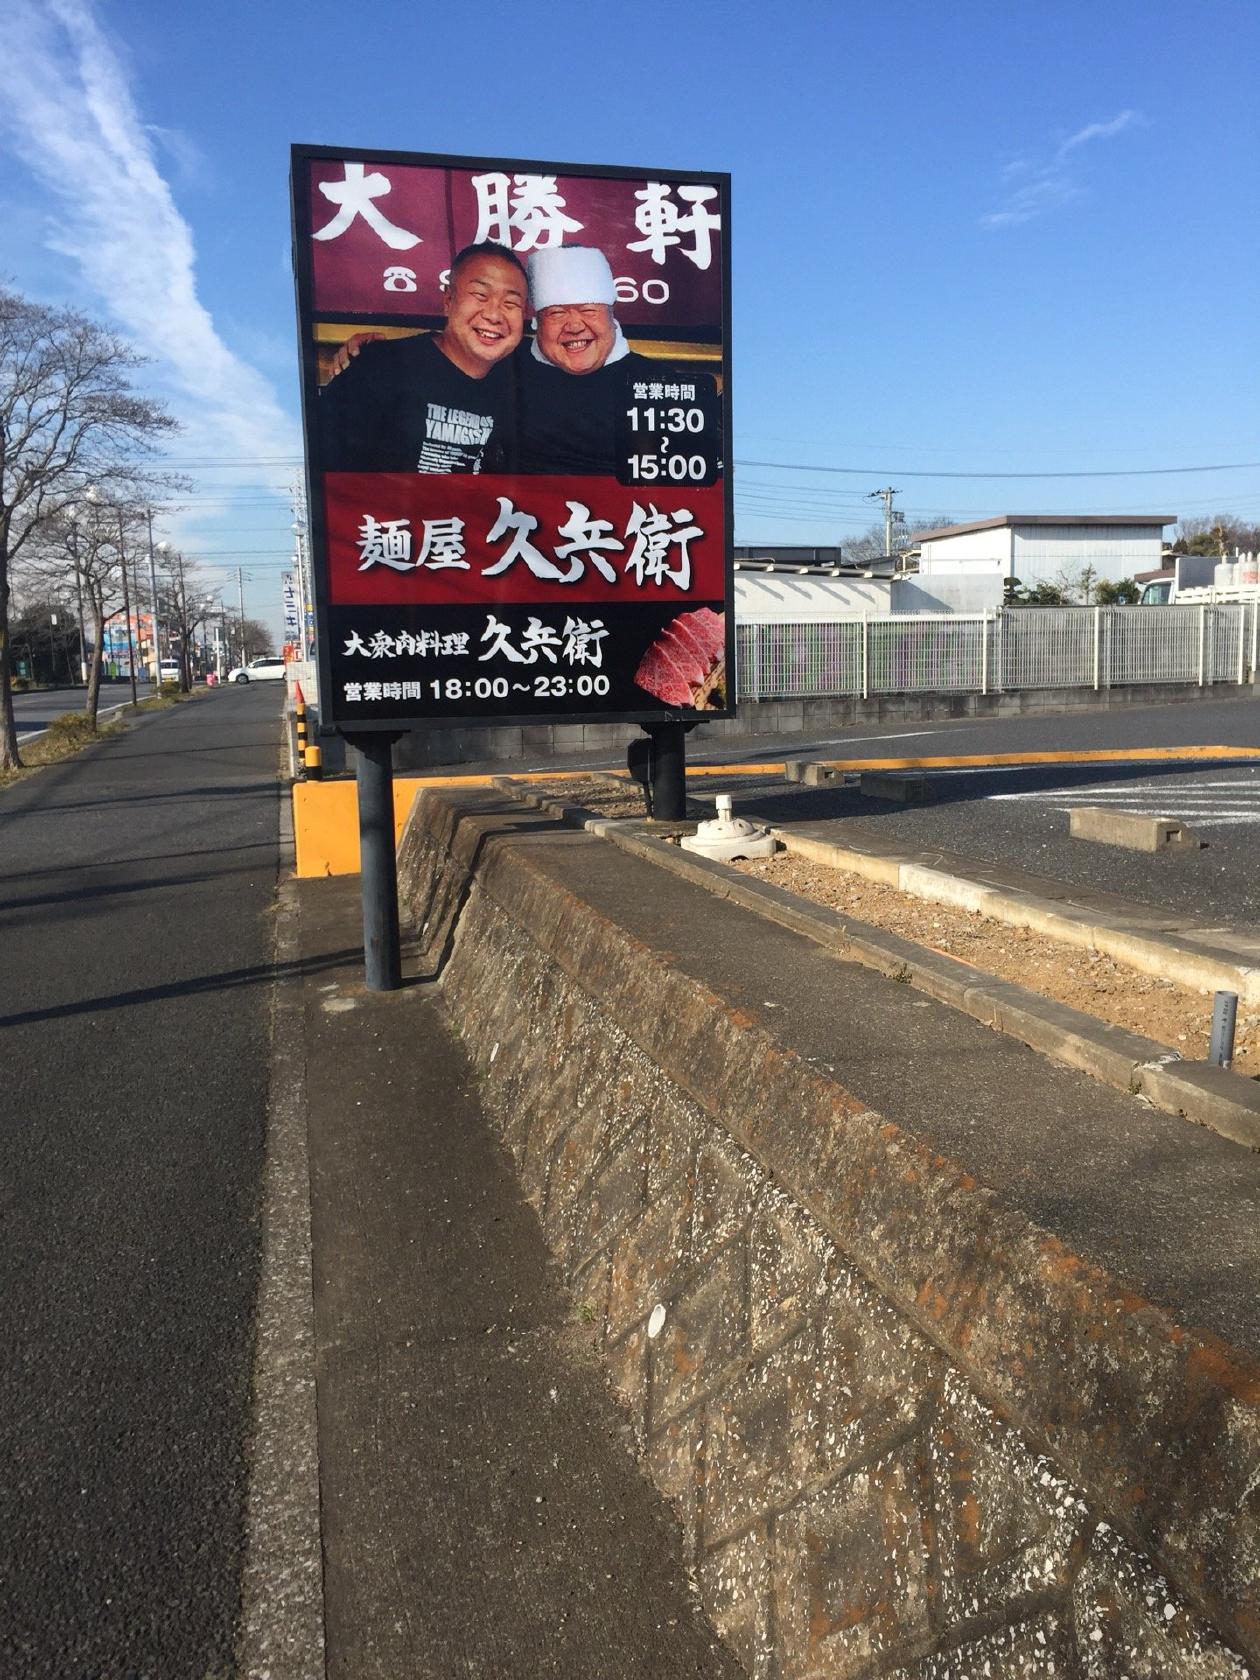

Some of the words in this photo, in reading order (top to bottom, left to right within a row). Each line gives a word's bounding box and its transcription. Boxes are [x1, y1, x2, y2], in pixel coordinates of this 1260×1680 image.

[312, 160, 722, 271] 大勝軒
[632, 382, 696, 402] 営業時間
[427, 403, 448, 422] THE
[626, 406, 705, 433] 11:30
[627, 454, 707, 480] 15:00
[355, 514, 471, 571] 麺屋
[480, 496, 704, 591] 久兵衛
[341, 629, 470, 659] 大衆肉料理
[478, 614, 610, 668] 久兵衛
[343, 681, 421, 702] 営業時間
